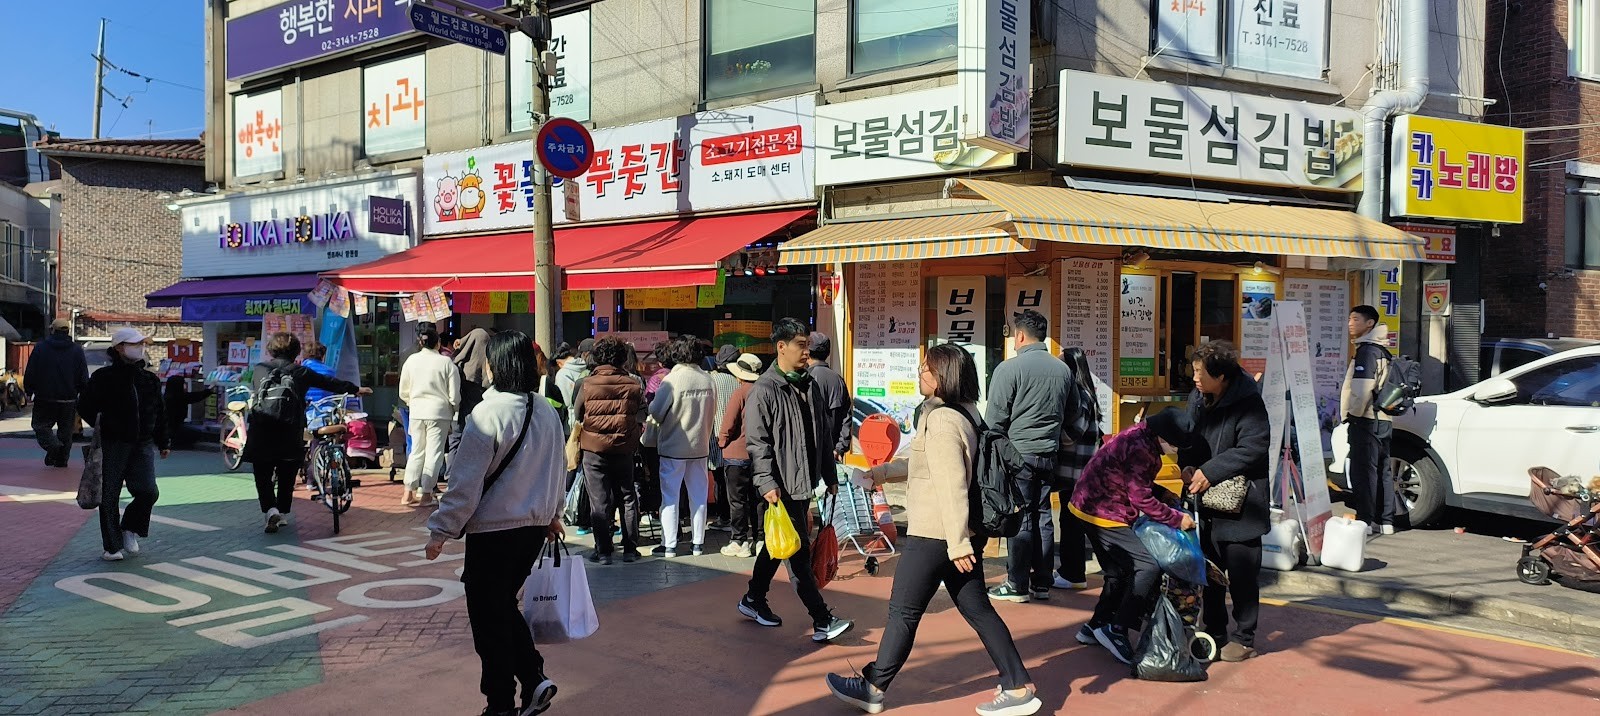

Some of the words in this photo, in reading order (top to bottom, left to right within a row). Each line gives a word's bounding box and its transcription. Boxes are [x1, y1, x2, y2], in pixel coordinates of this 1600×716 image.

[279, 0, 335, 45] 행복한
[413, 12, 424, 23] 52
[430, 10, 490, 40] 월드컵로19길
[1253, 0, 1301, 29] 진료
[321, 28, 379, 50] 02-3141-7528
[427, 23, 449, 39] World
[1242, 31, 1308, 53] T.3141-7528
[551, 35, 567, 60] 간
[551, 67, 567, 90] 료
[999, 0, 1018, 140] 물섬김밥
[368, 77, 425, 129] 치과
[238, 110, 281, 159] 행복한
[704, 130, 798, 160] 소고기전문점
[830, 105, 959, 160] 보물섬김
[1085, 91, 1343, 178] 보물섬김밥
[547, 142, 585, 154] 주차금지
[587, 138, 687, 200] 푸줏간
[711, 166, 743, 184] 소,돼지
[746, 165, 767, 179] 도매
[770, 162, 791, 176] 센터
[1411, 131, 1434, 200] 카카
[1438, 149, 1519, 193] 노래방
[373, 205, 402, 217] HOLIKA
[373, 215, 402, 225] HOLIKA
[218, 220, 282, 248] HOLIKA
[284, 211, 356, 243] HOLIKA
[246, 300, 271, 315] 최저가
[1122, 309, 1152, 321] 채식김밥
[946, 289, 976, 358] 보물
[1121, 377, 1148, 387] 단체주문
[540, 594, 558, 602] Brand
